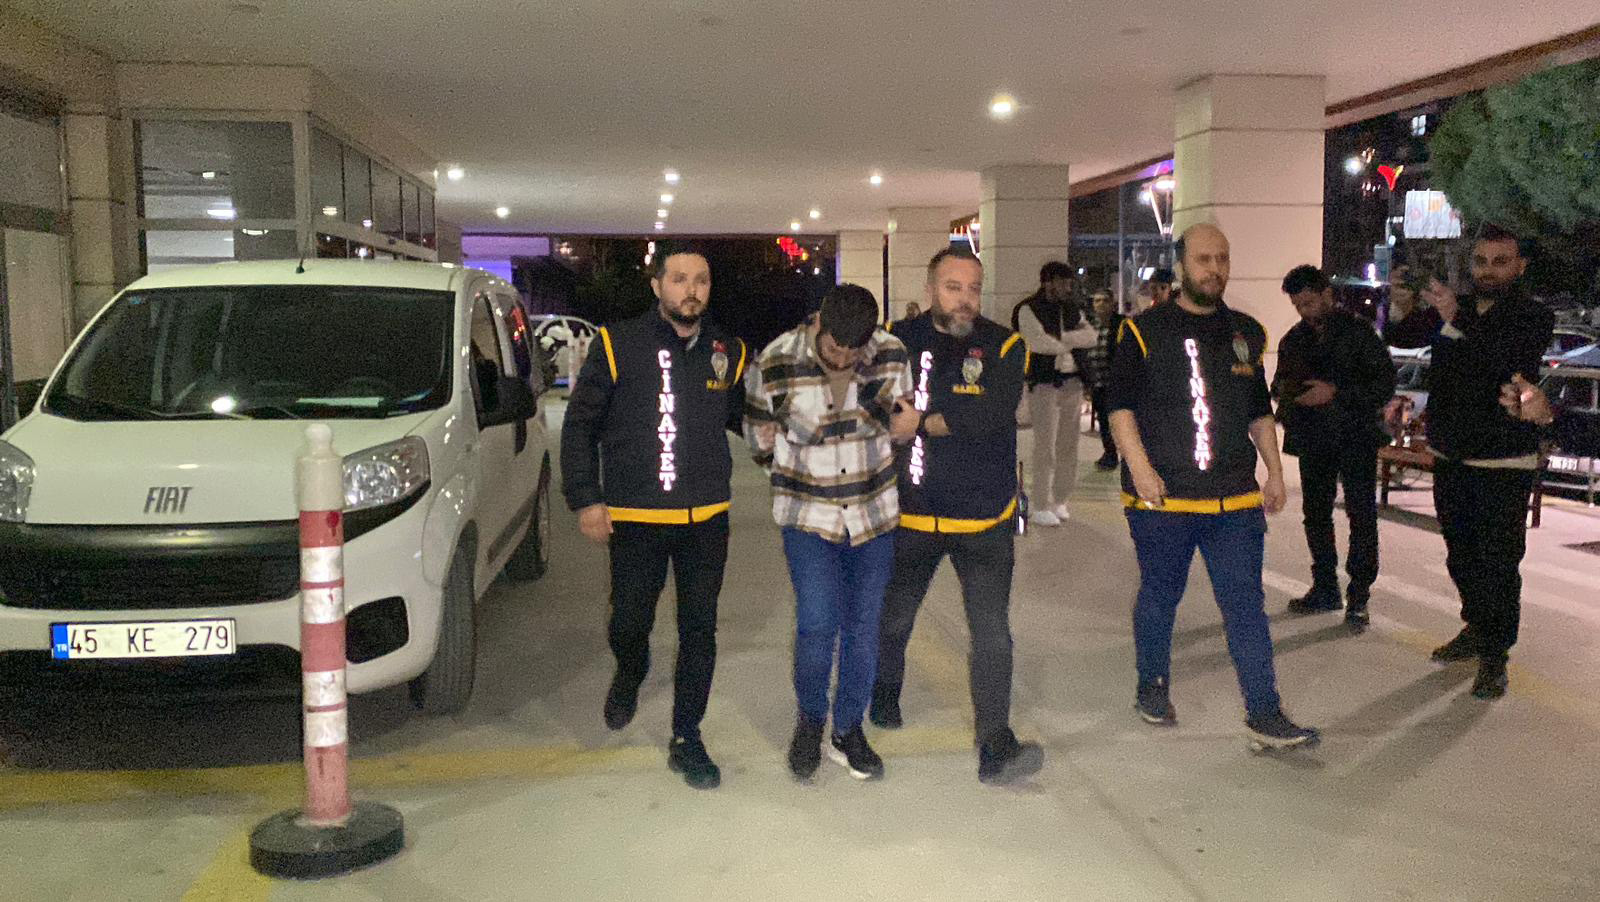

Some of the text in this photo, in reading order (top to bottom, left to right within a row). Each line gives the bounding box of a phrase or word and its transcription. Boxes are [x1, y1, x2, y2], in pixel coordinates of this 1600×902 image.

[143, 486, 193, 513] FIAT
[56, 625, 229, 654] TR 45 KE 279
